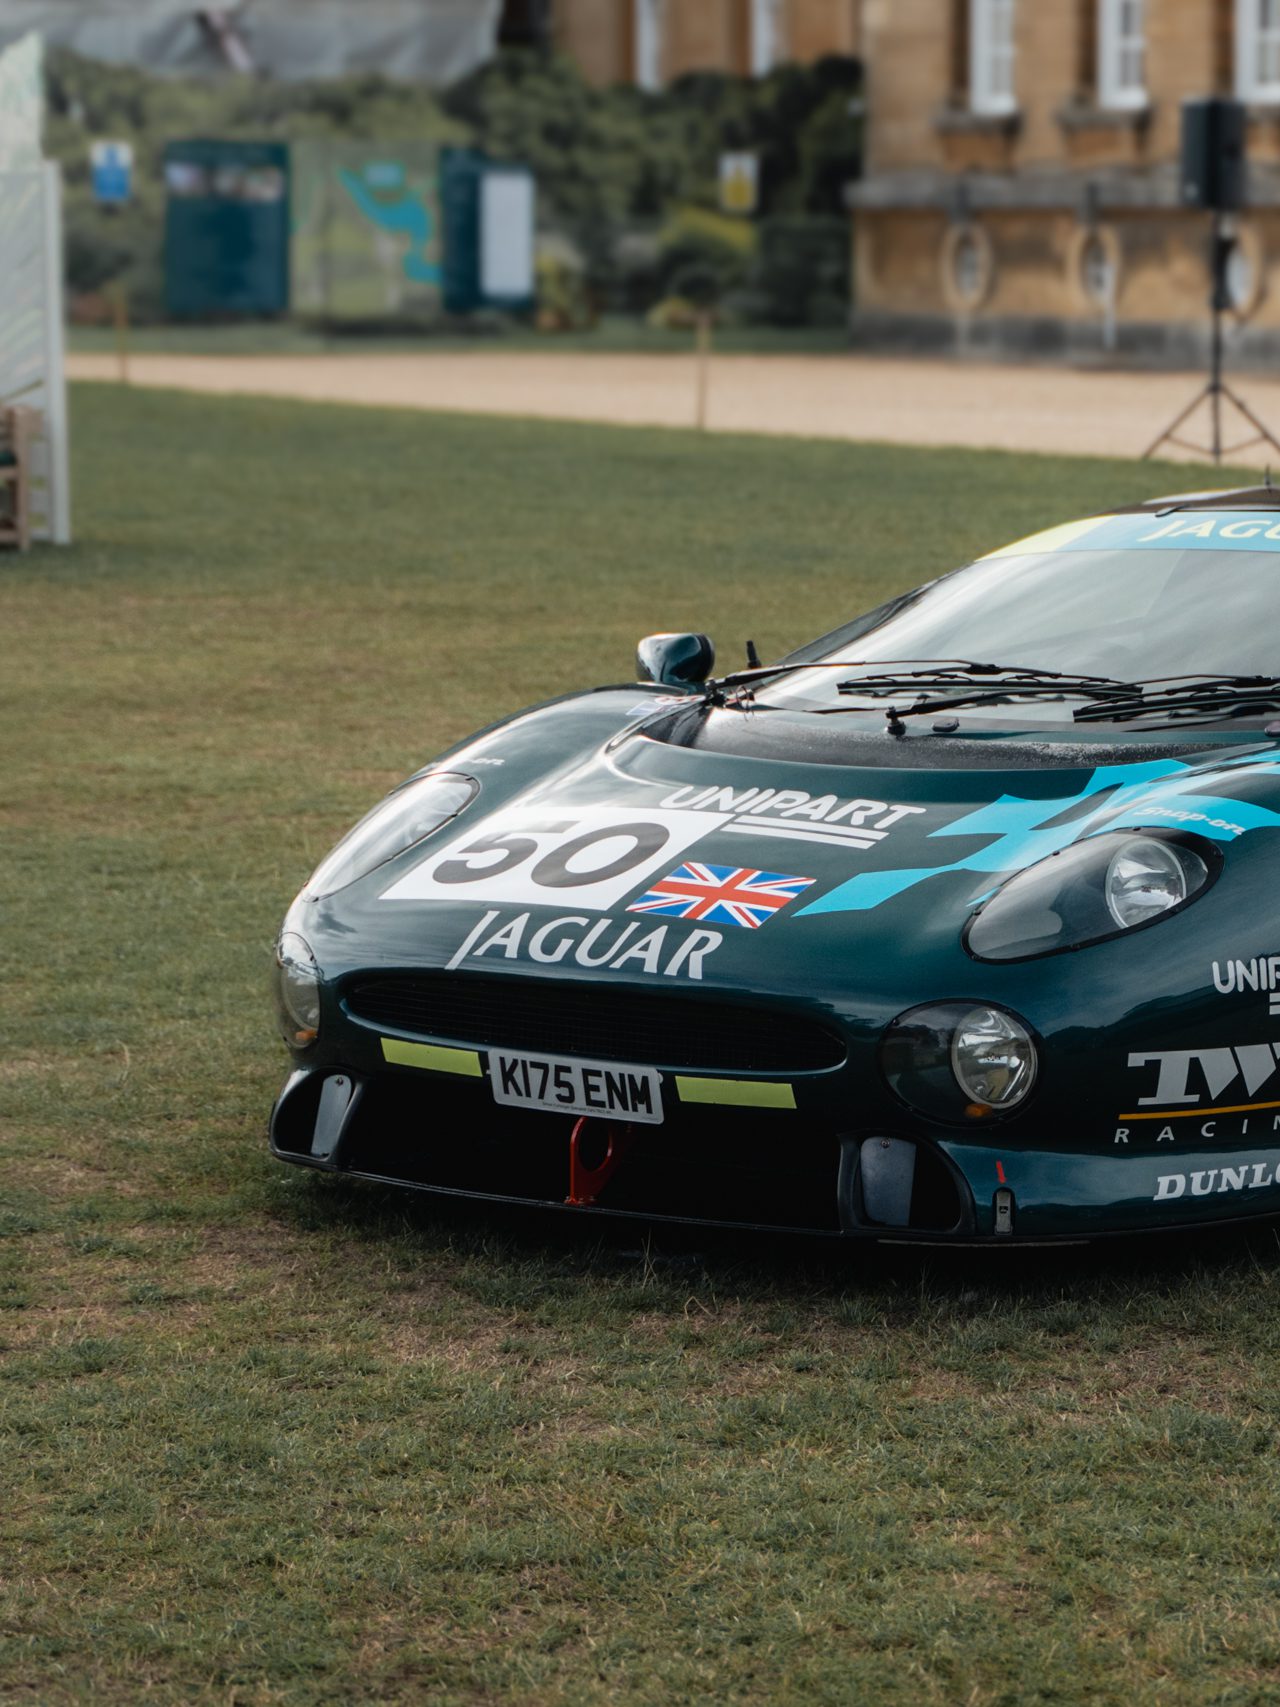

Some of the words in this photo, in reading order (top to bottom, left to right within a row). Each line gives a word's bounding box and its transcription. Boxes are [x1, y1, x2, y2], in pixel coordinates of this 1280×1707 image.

[659, 784, 927, 830] UNIPART
[432, 820, 671, 889] 50
[444, 910, 724, 981] JAGUAR
[581, 1068, 653, 1114] ENM
